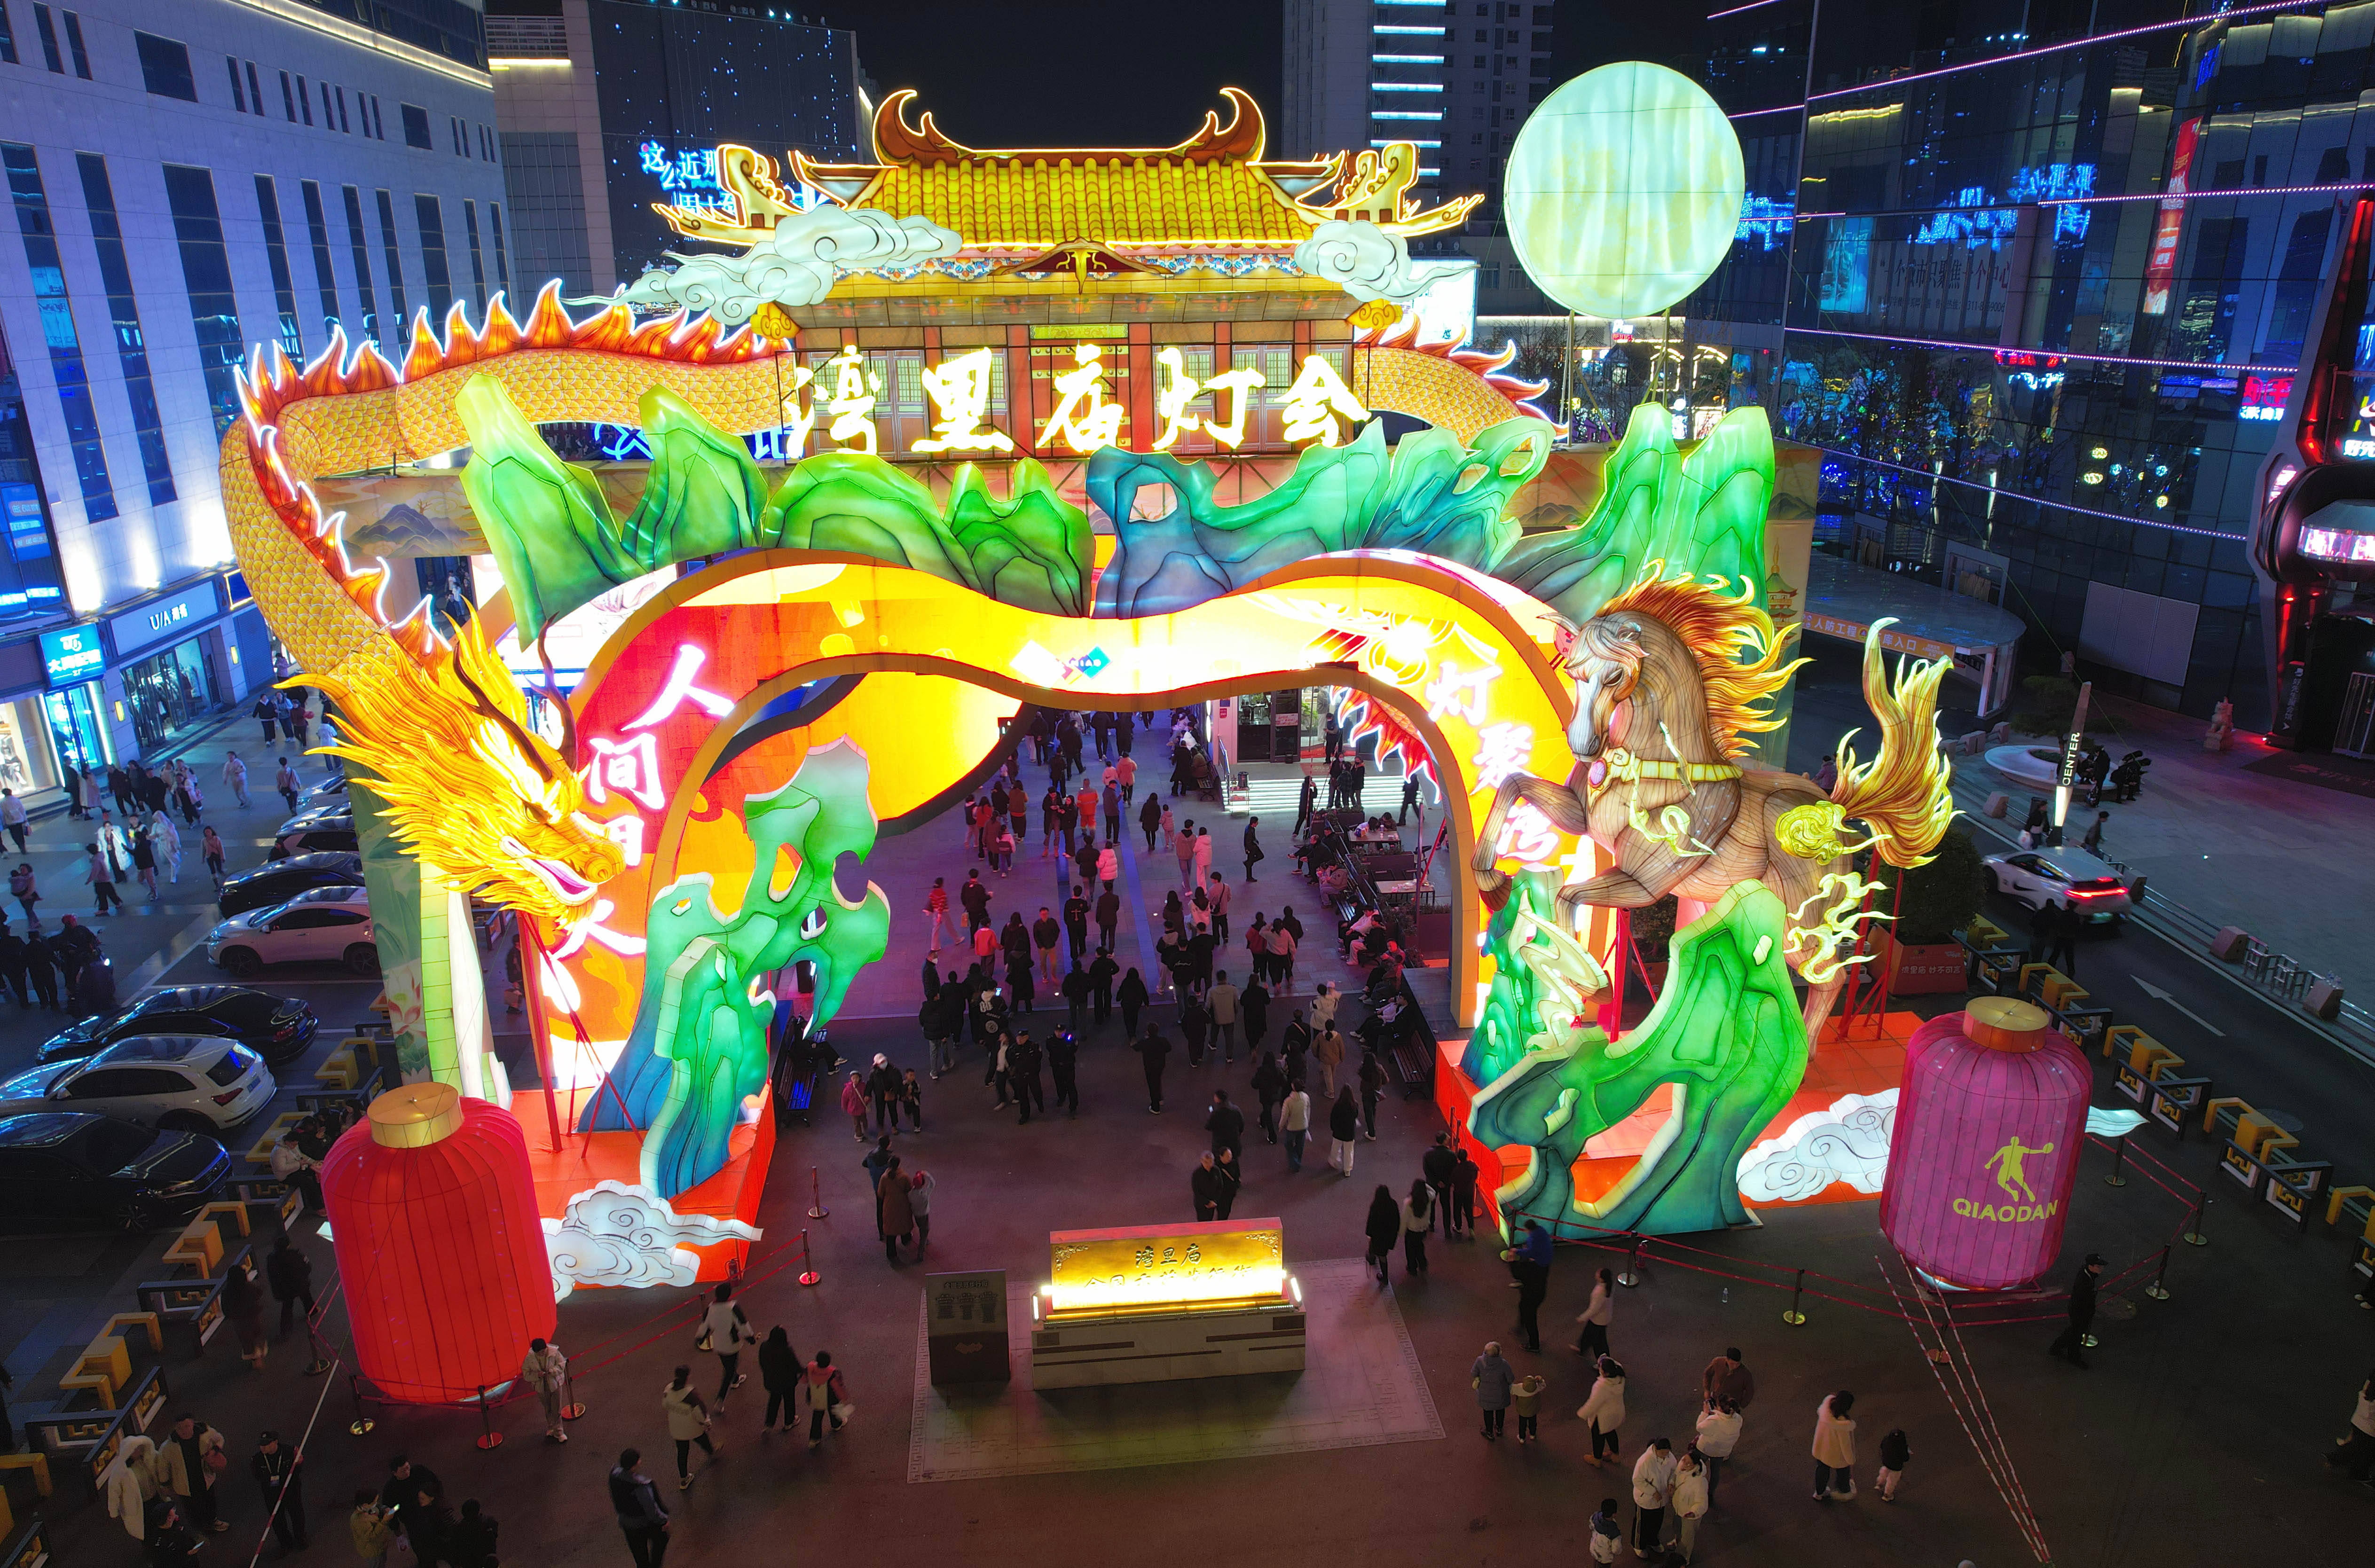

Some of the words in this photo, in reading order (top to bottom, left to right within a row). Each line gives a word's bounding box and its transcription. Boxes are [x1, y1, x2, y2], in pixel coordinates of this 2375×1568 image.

[784, 345, 1372, 456] 湾里庙灯会
[1814, 620, 1857, 638] 人防工程
[1878, 633, 1917, 651] 库入口
[2062, 732, 2080, 785] CENTER
[1952, 1198, 2058, 1223] QIAODAN
[1135, 1243, 1202, 1269] 湾里庙
